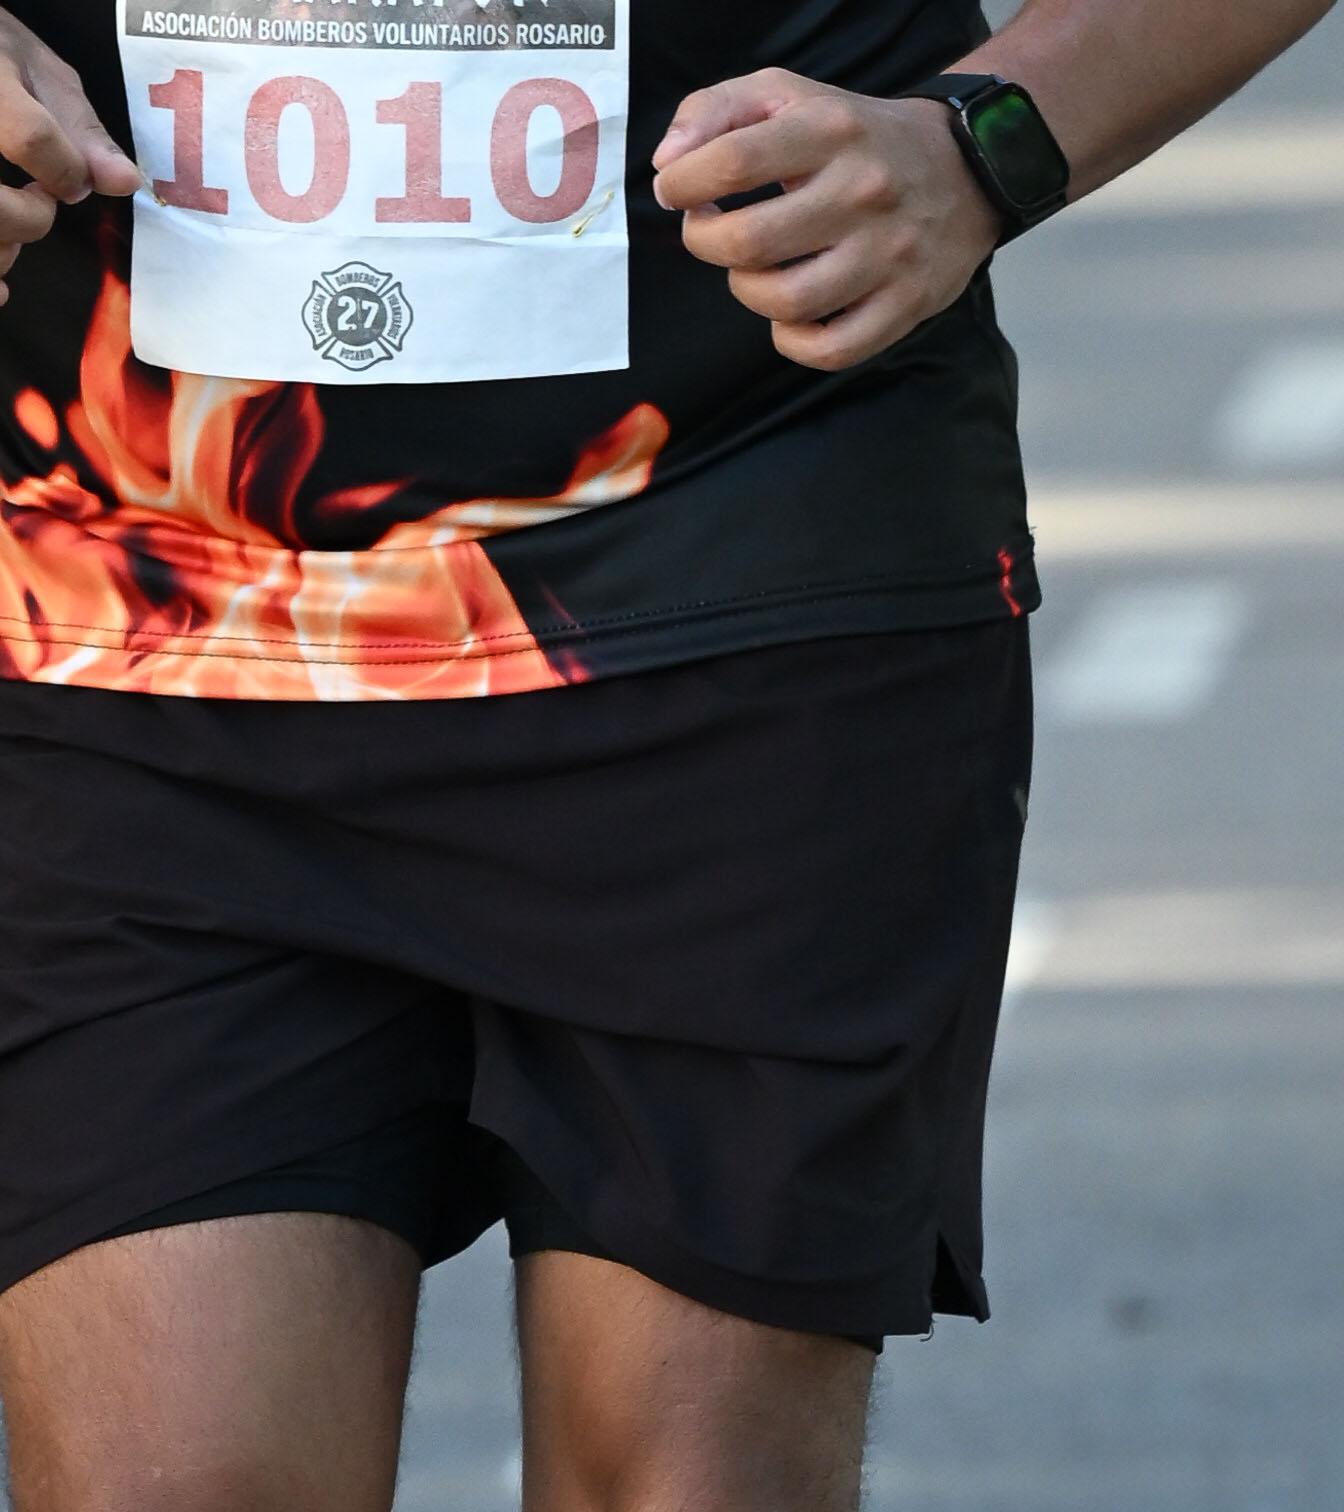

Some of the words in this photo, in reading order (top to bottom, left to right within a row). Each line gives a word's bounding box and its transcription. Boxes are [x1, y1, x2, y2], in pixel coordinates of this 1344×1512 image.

[141, 10, 252, 39] ASOCIACIÓN
[257, 18, 367, 44] BOMBEROS
[373, 21, 510, 46] VOLUNTARIOS
[515, 23, 606, 46] ROSARIO
[147, 68, 600, 225] 1010
[337, 295, 380, 331] 27
